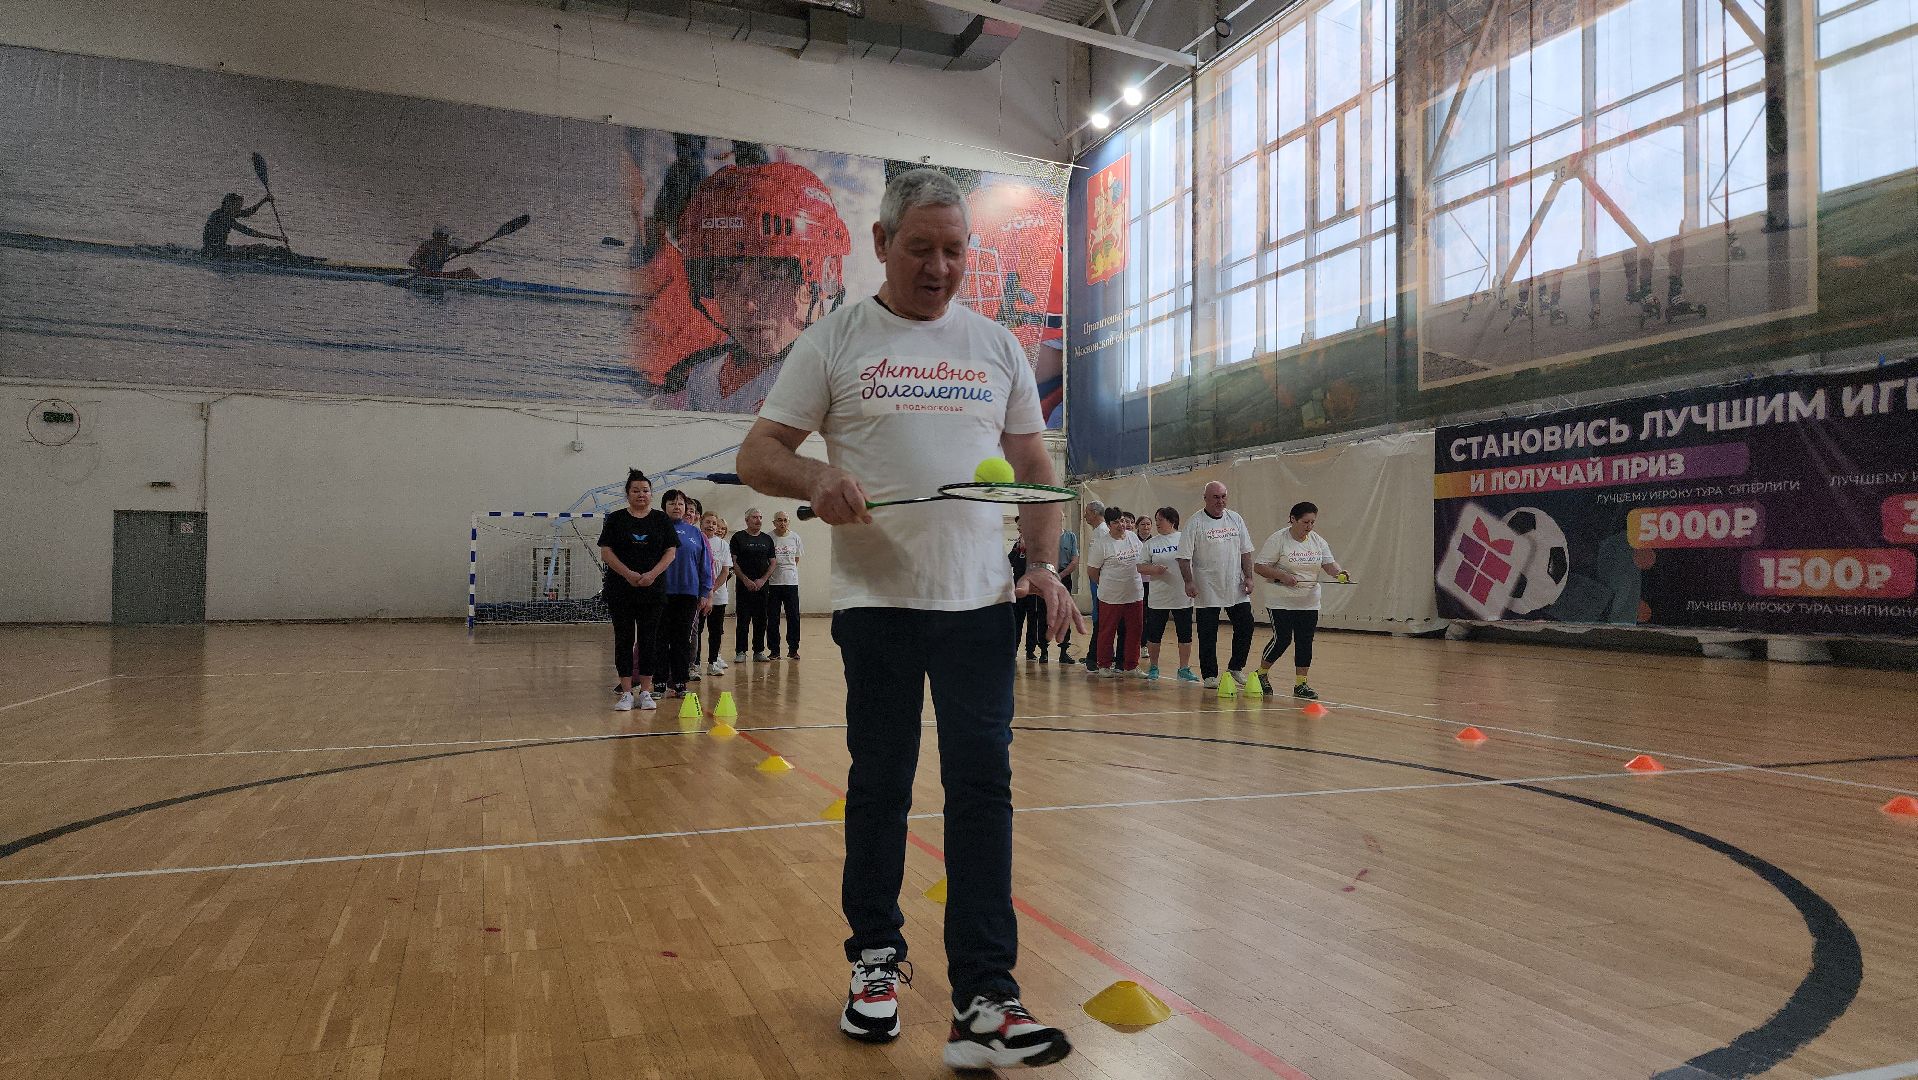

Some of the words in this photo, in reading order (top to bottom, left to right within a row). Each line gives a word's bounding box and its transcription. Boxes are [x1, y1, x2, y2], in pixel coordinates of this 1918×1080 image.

[1083, 308, 1131, 335] Правительс
[860, 358, 988, 383] Активное
[861, 377, 993, 403] долголетие
[1450, 417, 1630, 462] СТАНОВИСЬ
[1640, 388, 1826, 441] ЛУЧШИМ
[1470, 473, 1485, 493] И
[1491, 457, 1604, 491] ПОЛУЧАЙ
[1612, 452, 1685, 481] ПРИЗ
[1829, 472, 1906, 487] ЛУЧШЕМУ
[1596, 491, 1647, 504] ЛУЧШЕМУ
[1650, 488, 1692, 500] ИГРОКУ
[1695, 487, 1723, 497] ТУРА
[1729, 480, 1800, 495] СУПЕРЛИГИ
[1686, 600, 1745, 612] ЛУЧШЕМУ
[1747, 601, 1794, 614] ИГРОКУ
[1800, 603, 1833, 615] ТУРА
